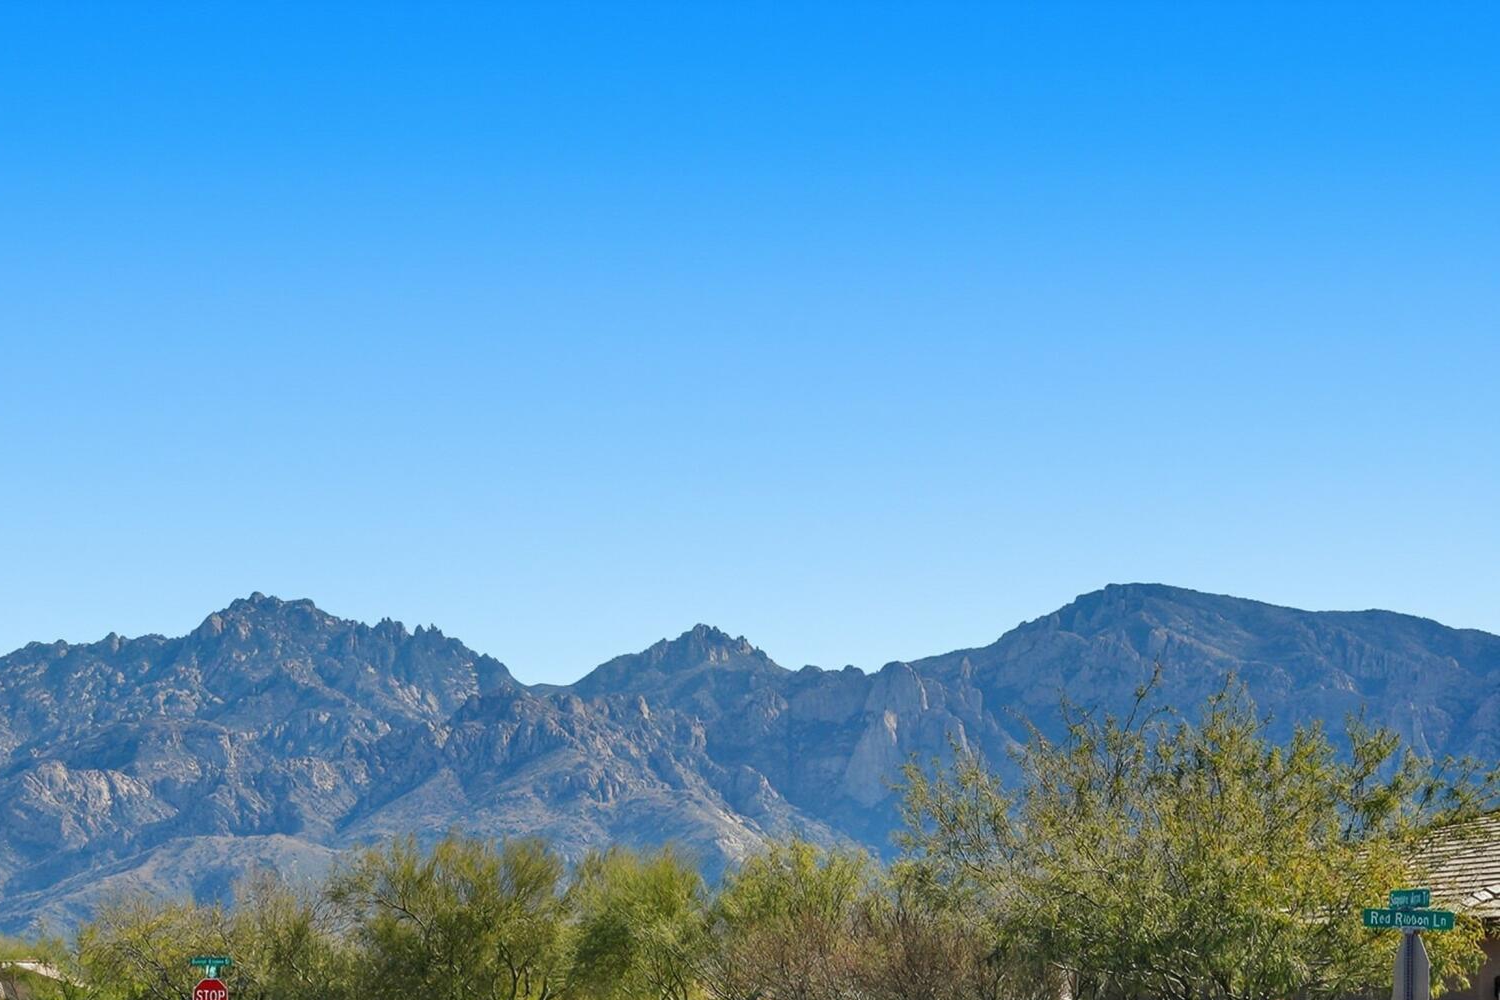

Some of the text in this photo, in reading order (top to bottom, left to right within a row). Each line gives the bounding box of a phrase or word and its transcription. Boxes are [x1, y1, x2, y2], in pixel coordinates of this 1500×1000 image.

[1370, 911, 1447, 927] Red Ribbon Ln
